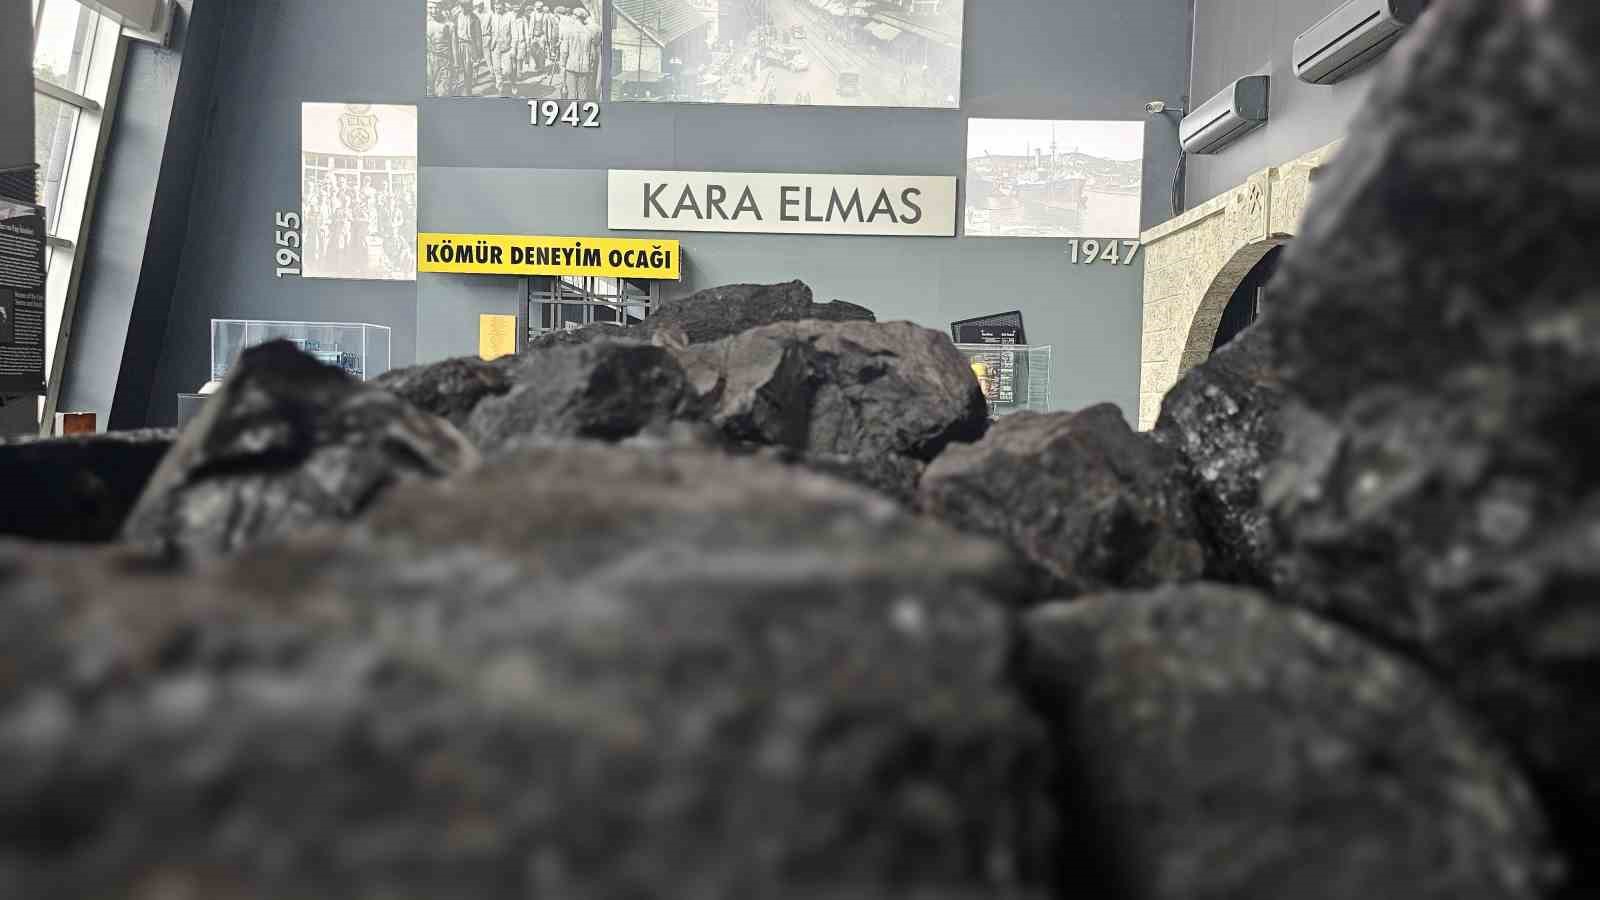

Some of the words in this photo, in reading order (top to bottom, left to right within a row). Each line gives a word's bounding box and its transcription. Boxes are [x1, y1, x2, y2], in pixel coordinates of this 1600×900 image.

[526, 100, 600, 127] 1942
[643, 182, 763, 220] KARA
[779, 186, 922, 225] ELMAS
[275, 211, 301, 278] 1955
[427, 240, 502, 265] KÖMÜR
[510, 241, 601, 267] DENEYİM
[608, 245, 671, 269] OCAĞI
[1068, 239, 1140, 265] 1947
